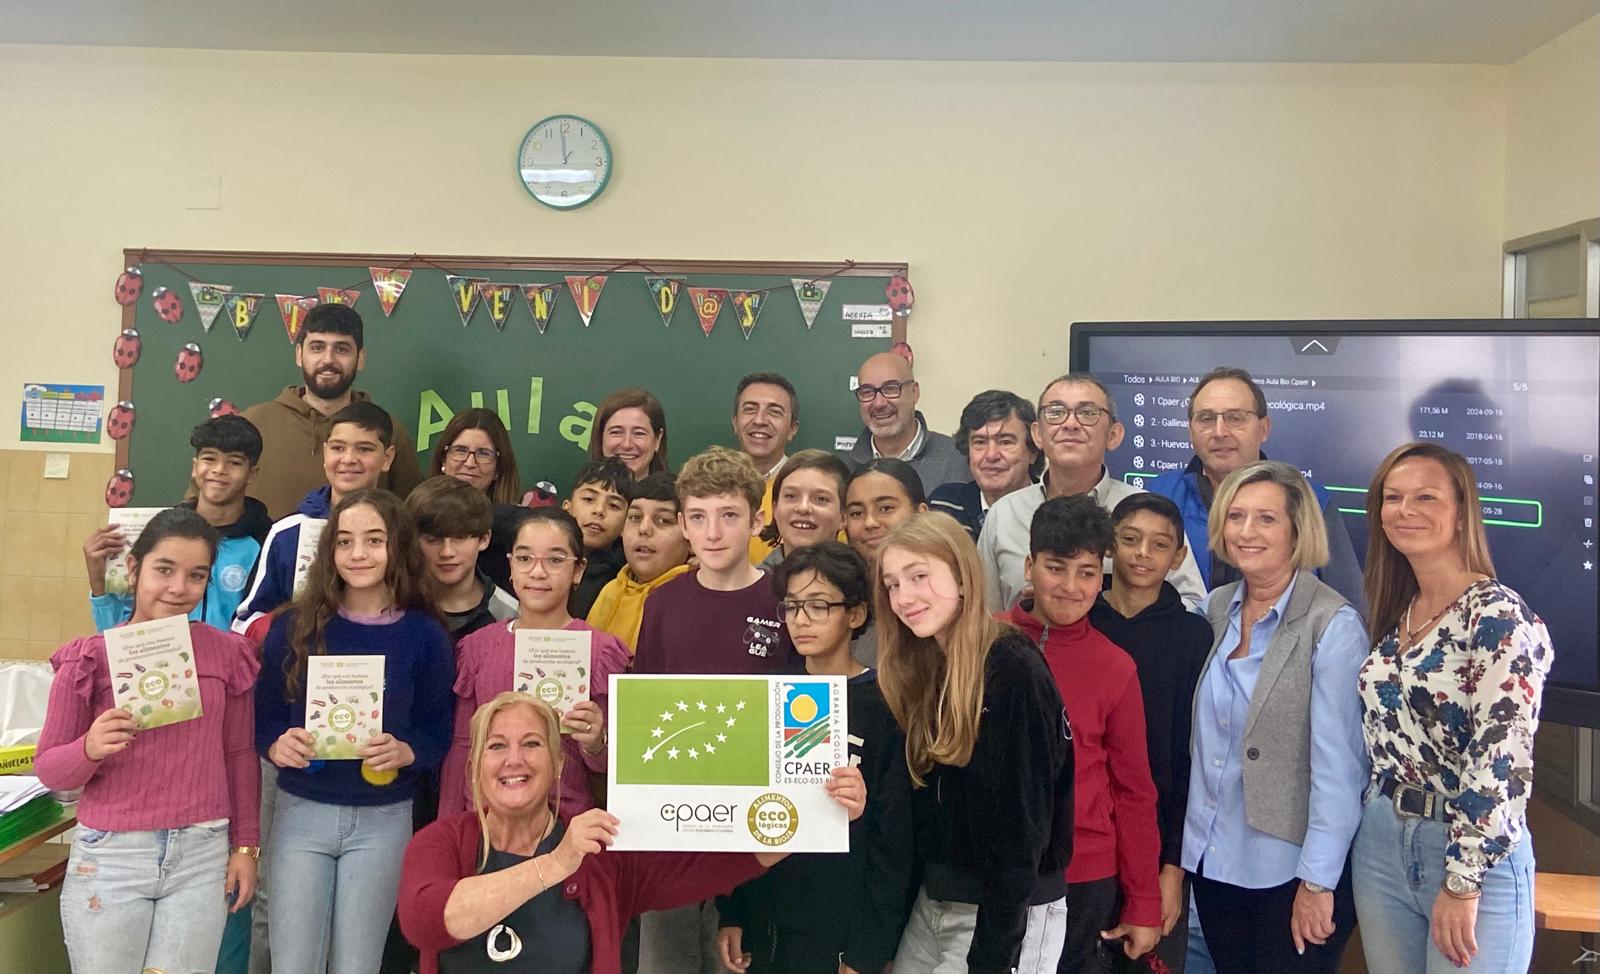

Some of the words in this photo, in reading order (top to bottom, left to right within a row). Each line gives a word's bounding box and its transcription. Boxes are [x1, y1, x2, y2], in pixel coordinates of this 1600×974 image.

[591, 140, 599, 150] 2
[526, 157, 534, 167] 9
[595, 157, 603, 167] 3
[1123, 374, 1146, 384] Todos
[1290, 378, 1309, 386] Cpaer
[1513, 382, 1528, 391] 5/5
[1157, 397, 1179, 407] Cpaer
[1466, 408, 1503, 416] 2024-09-16
[1161, 418, 1190, 427] Gallinas
[1466, 433, 1503, 441] 2018-04-16
[1161, 440, 1189, 449] Huevos
[1150, 460, 1156, 468] 4
[1156, 460, 1179, 470] Cpaer
[1466, 457, 1503, 465] 2017-05-18
[746, 616, 781, 629] GAMER
[750, 643, 767, 651] LEA
[748, 648, 767, 657] GUE
[145, 679, 162, 689] eco
[775, 730, 781, 739] LA
[775, 739, 781, 749] DE
[784, 761, 831, 775] CPAER
[753, 793, 793, 810] ALIMENTOS
[660, 803, 738, 832] cpaer
[758, 811, 787, 821] eco
[758, 821, 787, 830] lógicos
[753, 830, 764, 841] DE
[763, 837, 772, 845] LA
[774, 830, 794, 845] RIOJA
